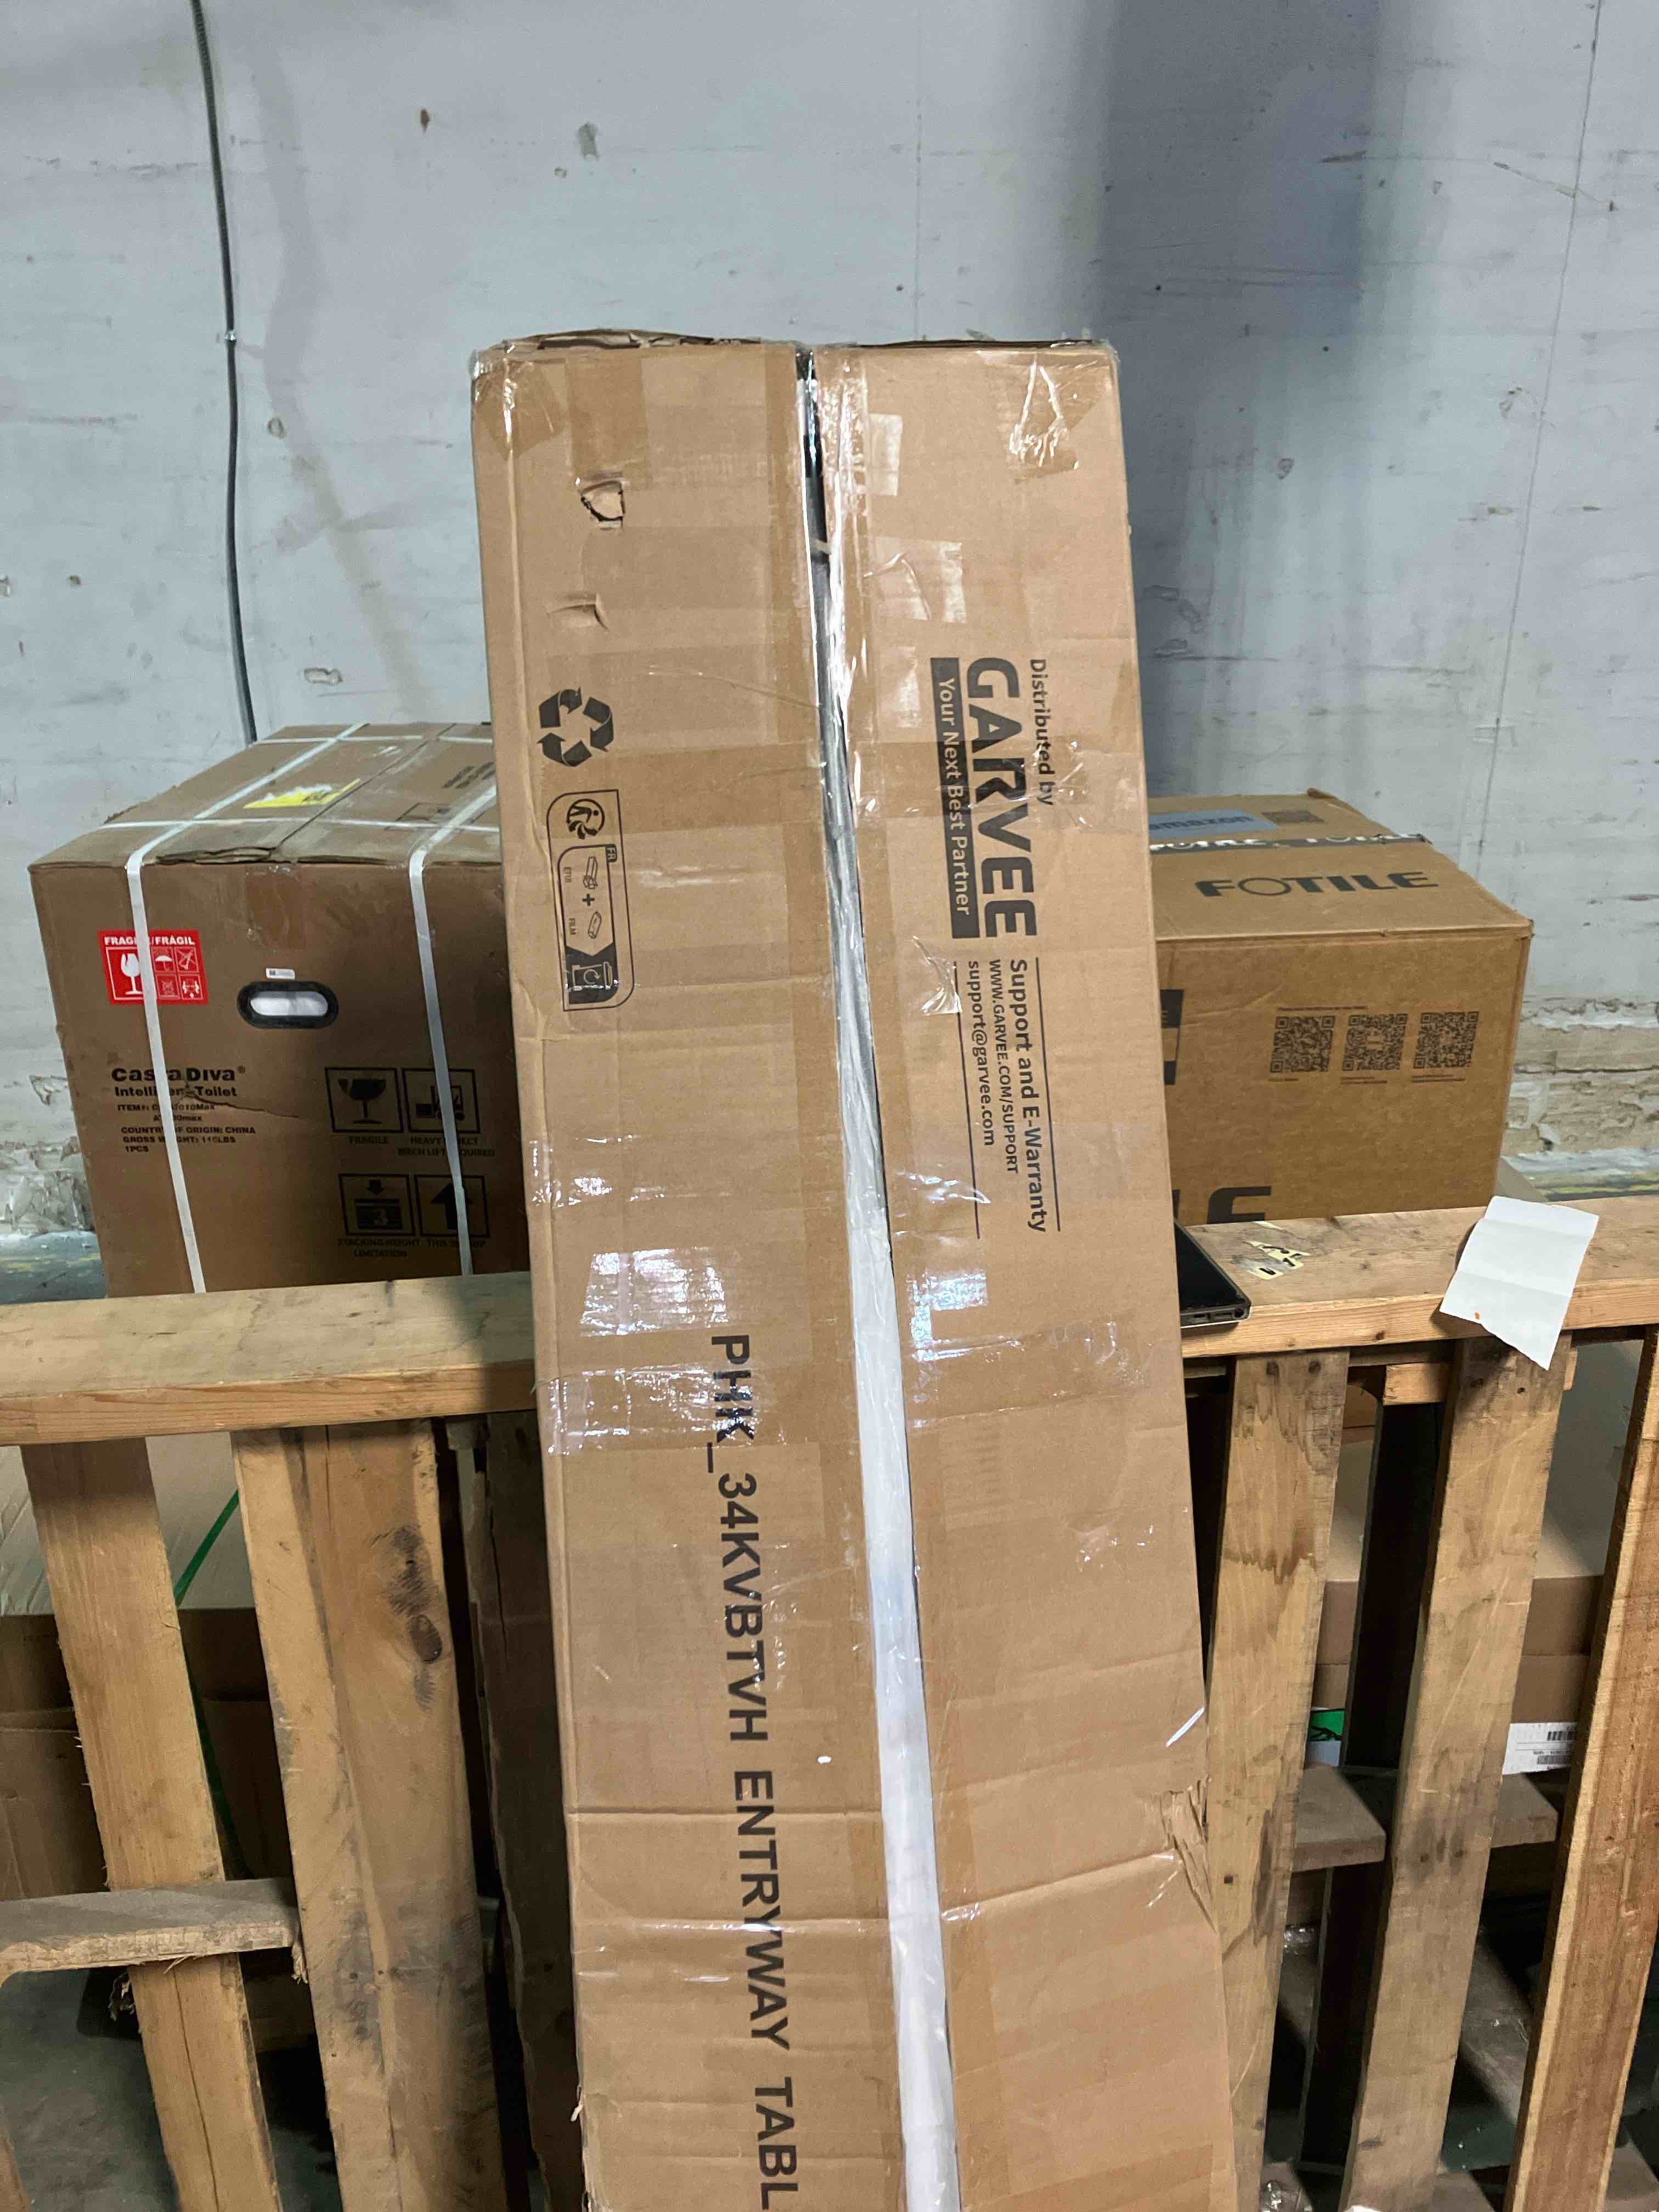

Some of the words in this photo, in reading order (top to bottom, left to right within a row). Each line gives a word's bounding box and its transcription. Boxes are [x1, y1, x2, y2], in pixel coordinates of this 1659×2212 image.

[939, 678, 956, 726] Your
[1030, 658, 1053, 775] Distributed
[943, 732, 963, 779] Next
[1038, 780, 1056, 806] by
[947, 785, 964, 830] Best
[967, 657, 1037, 937] GARVEE
[607, 848, 616, 860] FR
[951, 837, 970, 916] Partner
[1195, 871, 1439, 898] FOTILE
[1010, 959, 1033, 1052] Support
[111, 1068, 181, 1081] Casa
[194, 1086, 237, 1097] Toilet
[968, 960, 995, 1146] support@garvee.com
[989, 959, 1019, 1173] WWW.GARVEE.COM/SUPPORT
[1018, 1058, 1040, 1099] and
[1022, 1106, 1047, 1232] E-Warranty
[707, 1334, 769, 1742] PHK_34KVBTVH
[734, 1770, 791, 2051] ENTRYWAY
[754, 2076, 799, 2211] TABL
